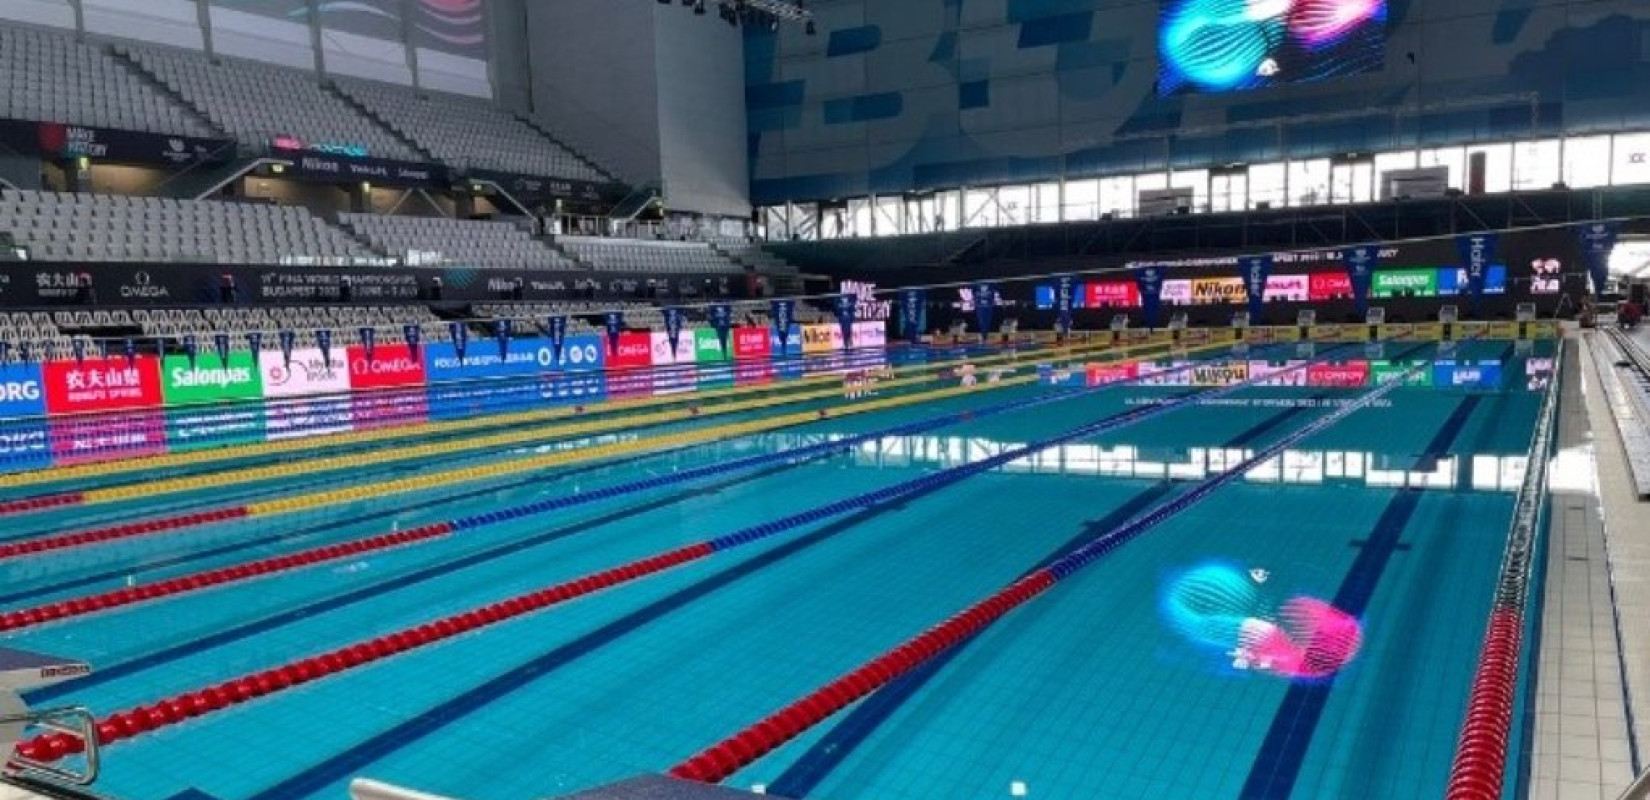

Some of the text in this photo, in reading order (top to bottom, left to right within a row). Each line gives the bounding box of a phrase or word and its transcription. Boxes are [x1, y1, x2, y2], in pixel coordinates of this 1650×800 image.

[1470, 237, 1486, 276] Haier
[1195, 279, 1246, 297] Nikon
[171, 366, 250, 389] Salonpas
